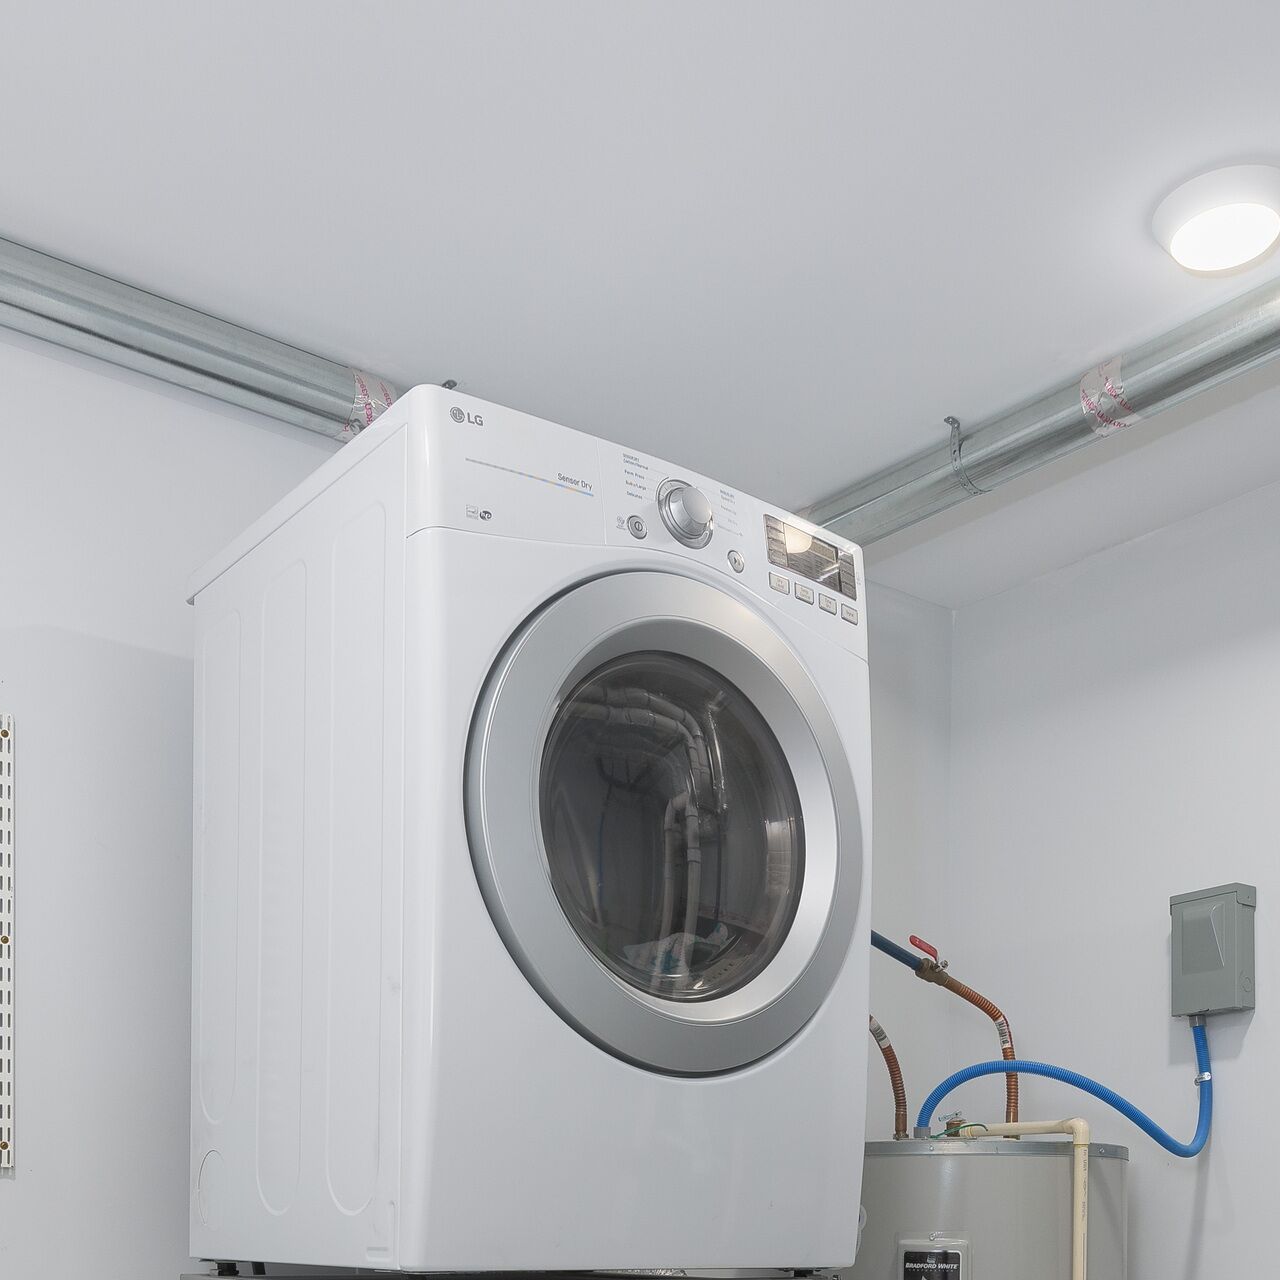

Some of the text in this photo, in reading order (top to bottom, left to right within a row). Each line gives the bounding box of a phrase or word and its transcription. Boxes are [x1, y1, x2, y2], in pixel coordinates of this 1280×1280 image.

[467, 412, 484, 426] LG
[557, 473, 593, 491] Sensor Dry
